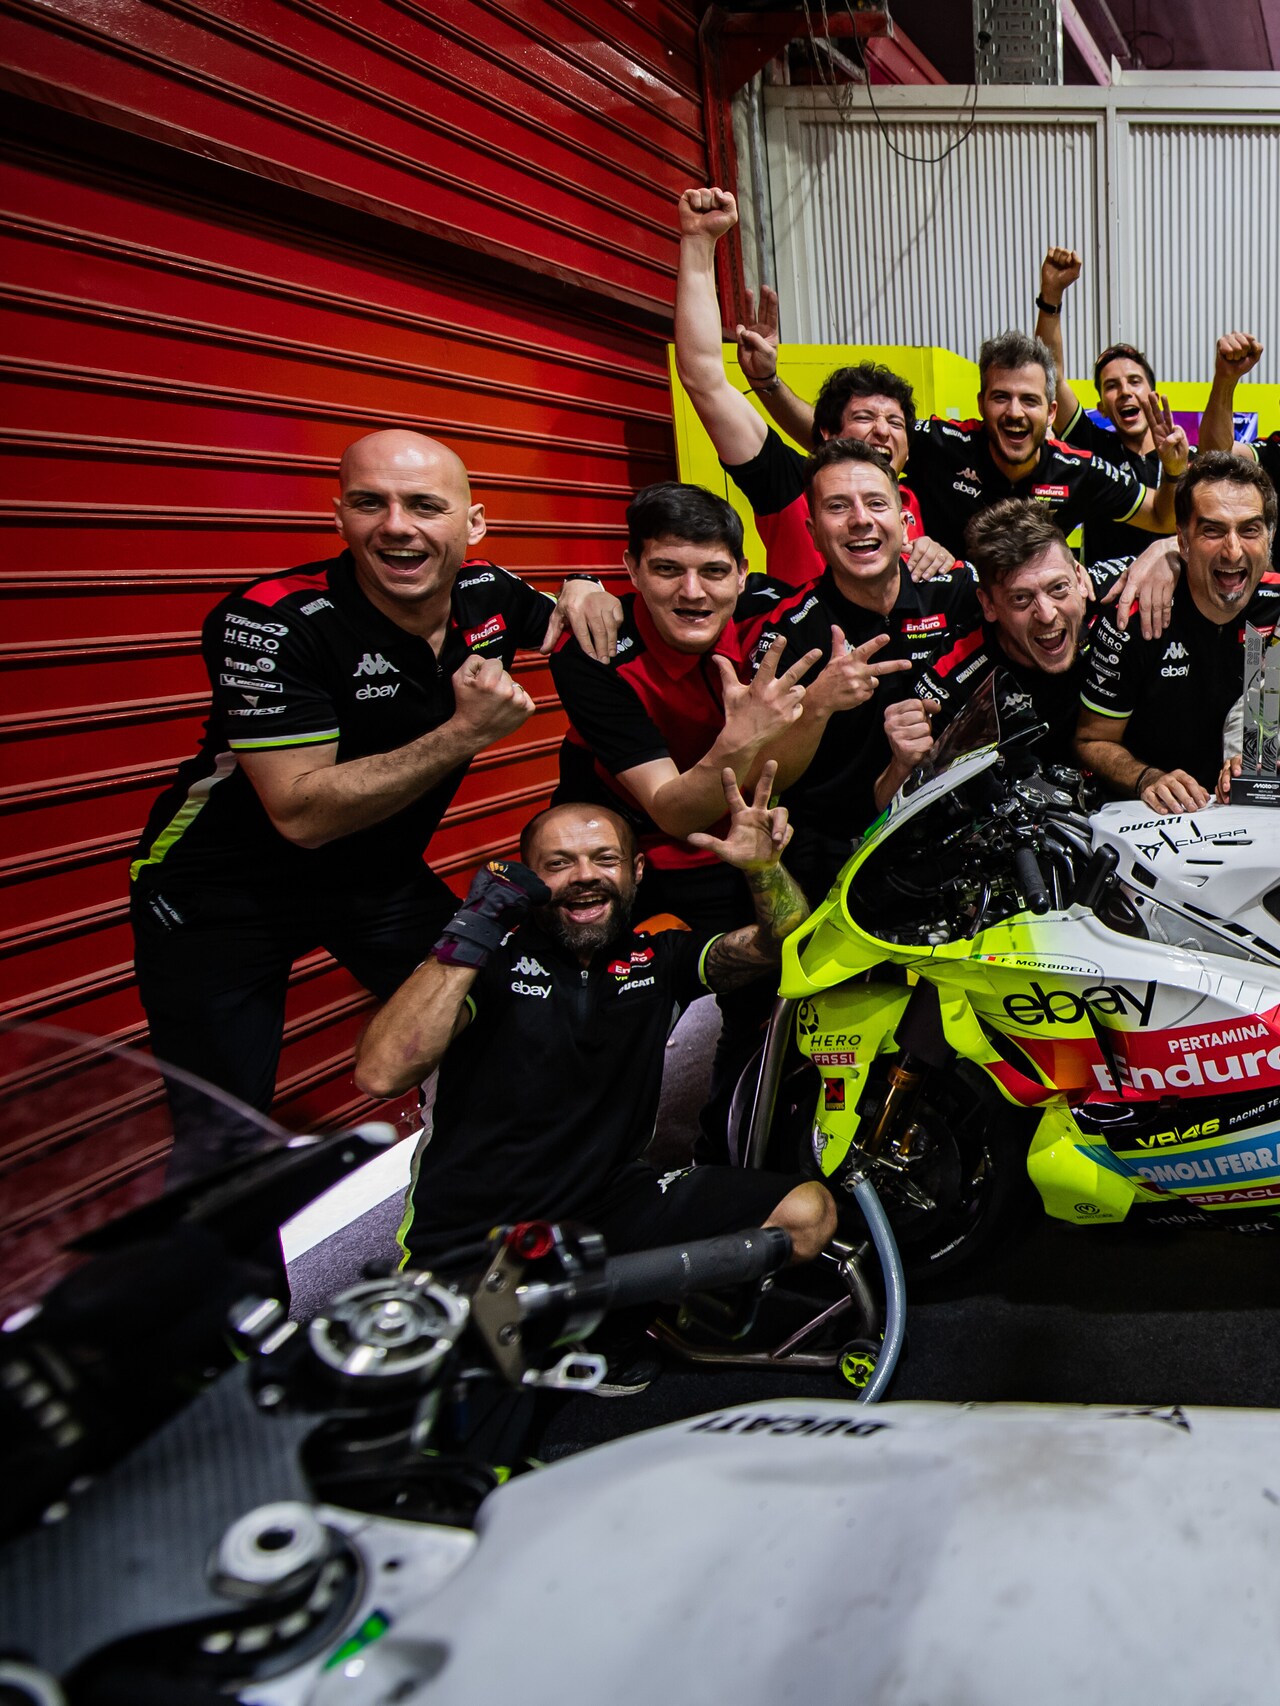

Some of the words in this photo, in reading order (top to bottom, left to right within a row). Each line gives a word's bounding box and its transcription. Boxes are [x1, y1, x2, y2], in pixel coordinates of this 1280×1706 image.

[952, 480, 981, 498] ebay
[470, 624, 500, 642] Enduro
[906, 620, 941, 631] Enduro
[224, 628, 280, 650] HERO
[1097, 628, 1123, 651] HERO
[1160, 664, 1191, 678] ebay
[356, 683, 400, 700] ebay
[1118, 816, 1182, 834] DUCATI
[1175, 829, 1247, 847] CUPRA
[1015, 959, 1099, 974] MORBIDELLI
[511, 980, 552, 999] ebay
[1001, 980, 1158, 1027] ebay
[811, 1034, 862, 1047] HERO
[1167, 1023, 1270, 1054] PERTAMINA
[814, 1054, 853, 1064] FASSI
[1229, 1103, 1266, 1126] RACING
[1138, 1158, 1213, 1184] OMOLI
